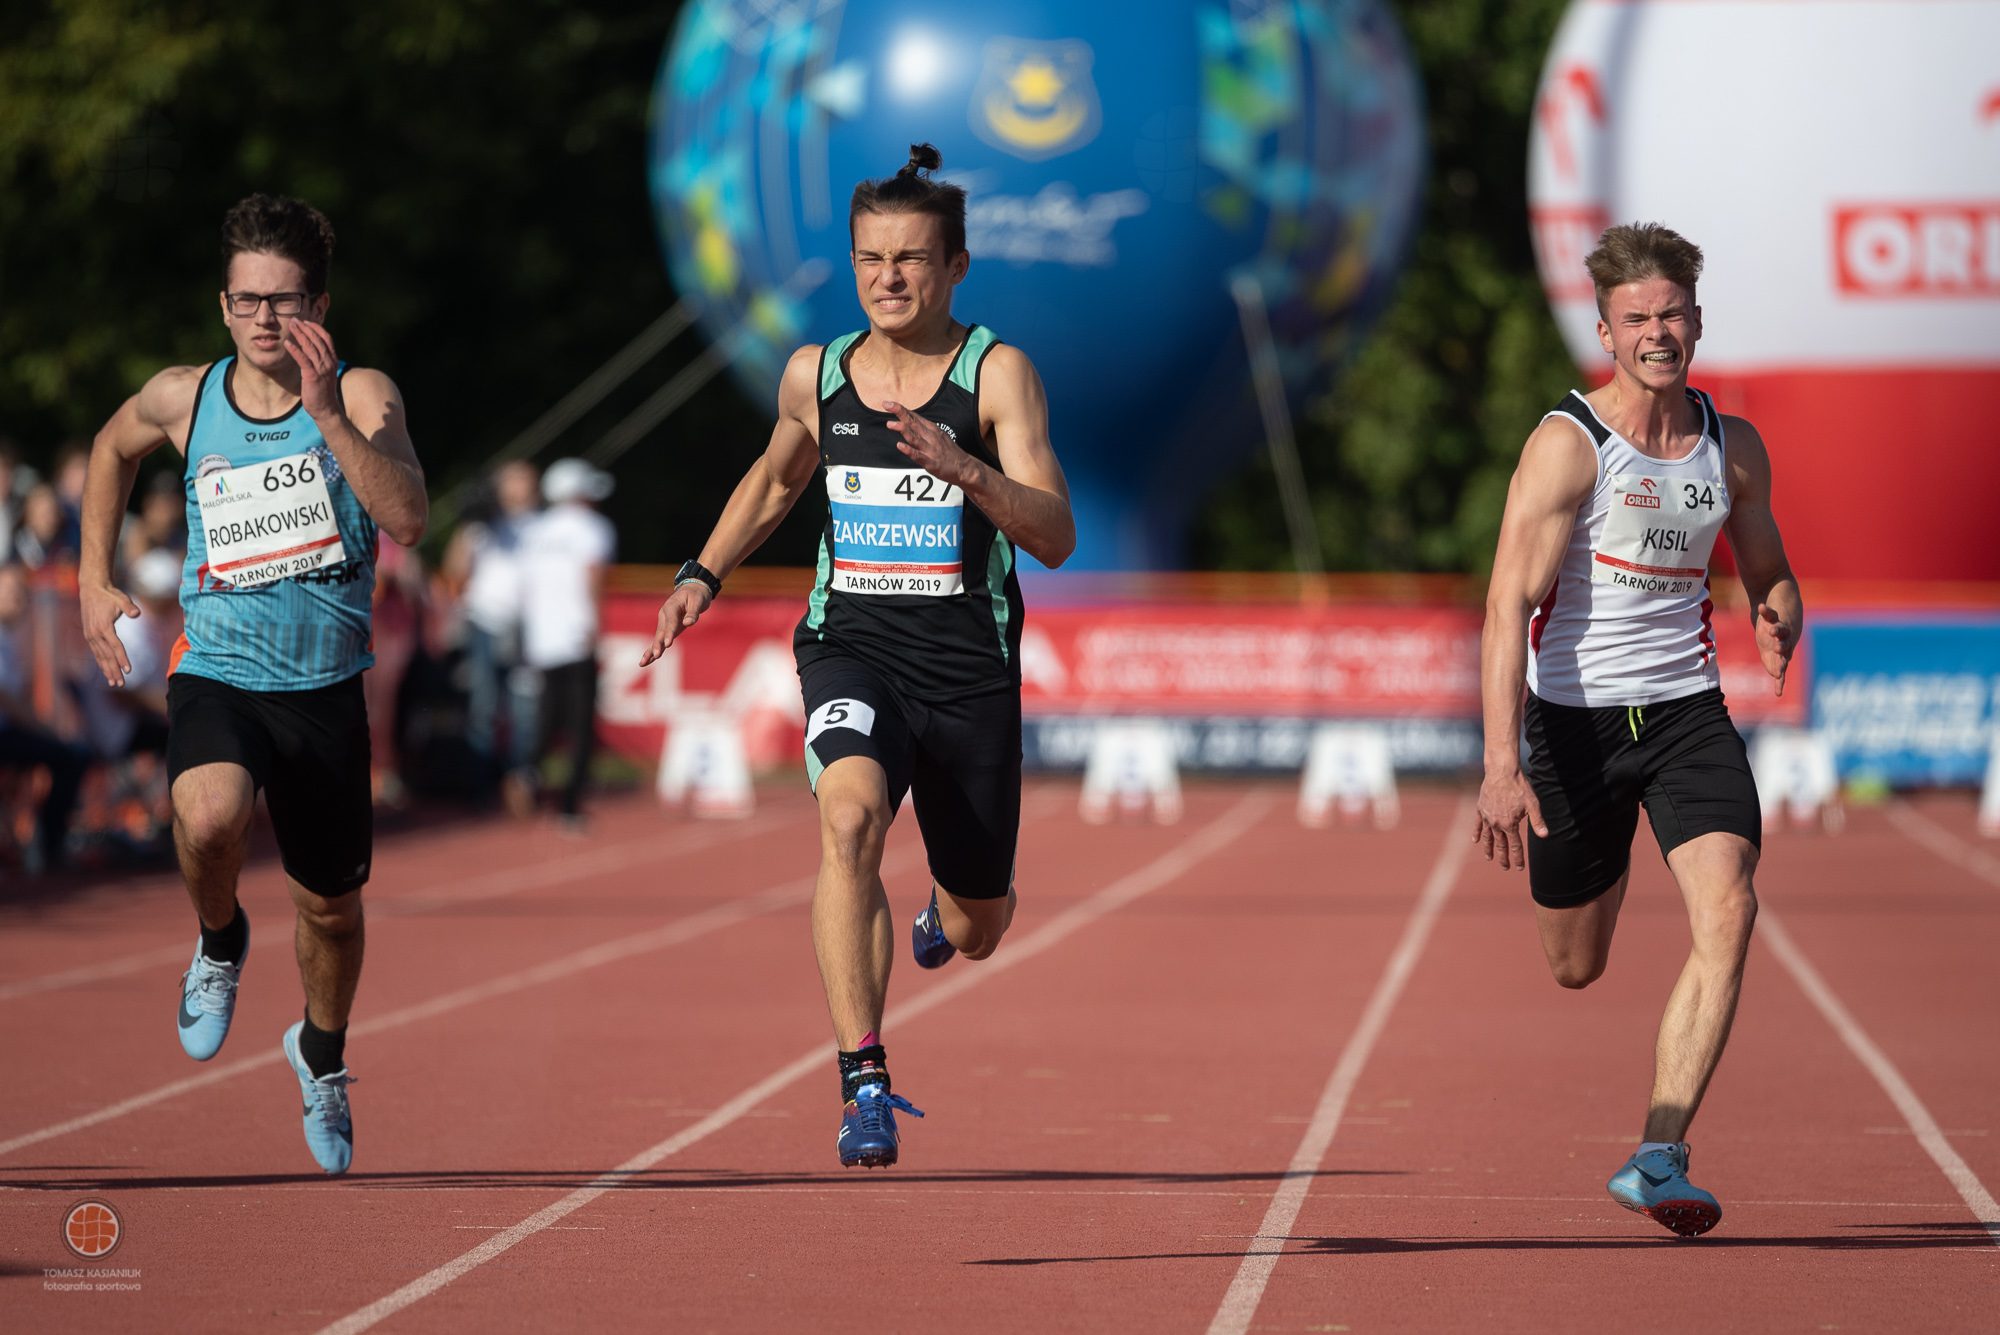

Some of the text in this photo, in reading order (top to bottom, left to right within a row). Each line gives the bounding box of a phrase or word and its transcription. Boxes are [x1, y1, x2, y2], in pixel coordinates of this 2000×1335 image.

[832, 422, 859, 436] esa
[263, 458, 316, 492] 636
[202, 491, 253, 510] MAŁOPOLSKA
[1626, 495, 1659, 508] ORLEN
[1683, 483, 1715, 511] 34
[209, 501, 329, 549] ROBAKOWSKI
[832, 519, 957, 548] ZAKRZEWSKI
[1643, 527, 1689, 552] KISIL
[231, 563, 289, 586] TARNÓW
[292, 553, 323, 572] 2019
[845, 574, 942, 592] TARNÓW 2019
[1613, 571, 1693, 593] TARNÓW 2019
[823, 702, 850, 725] 5
